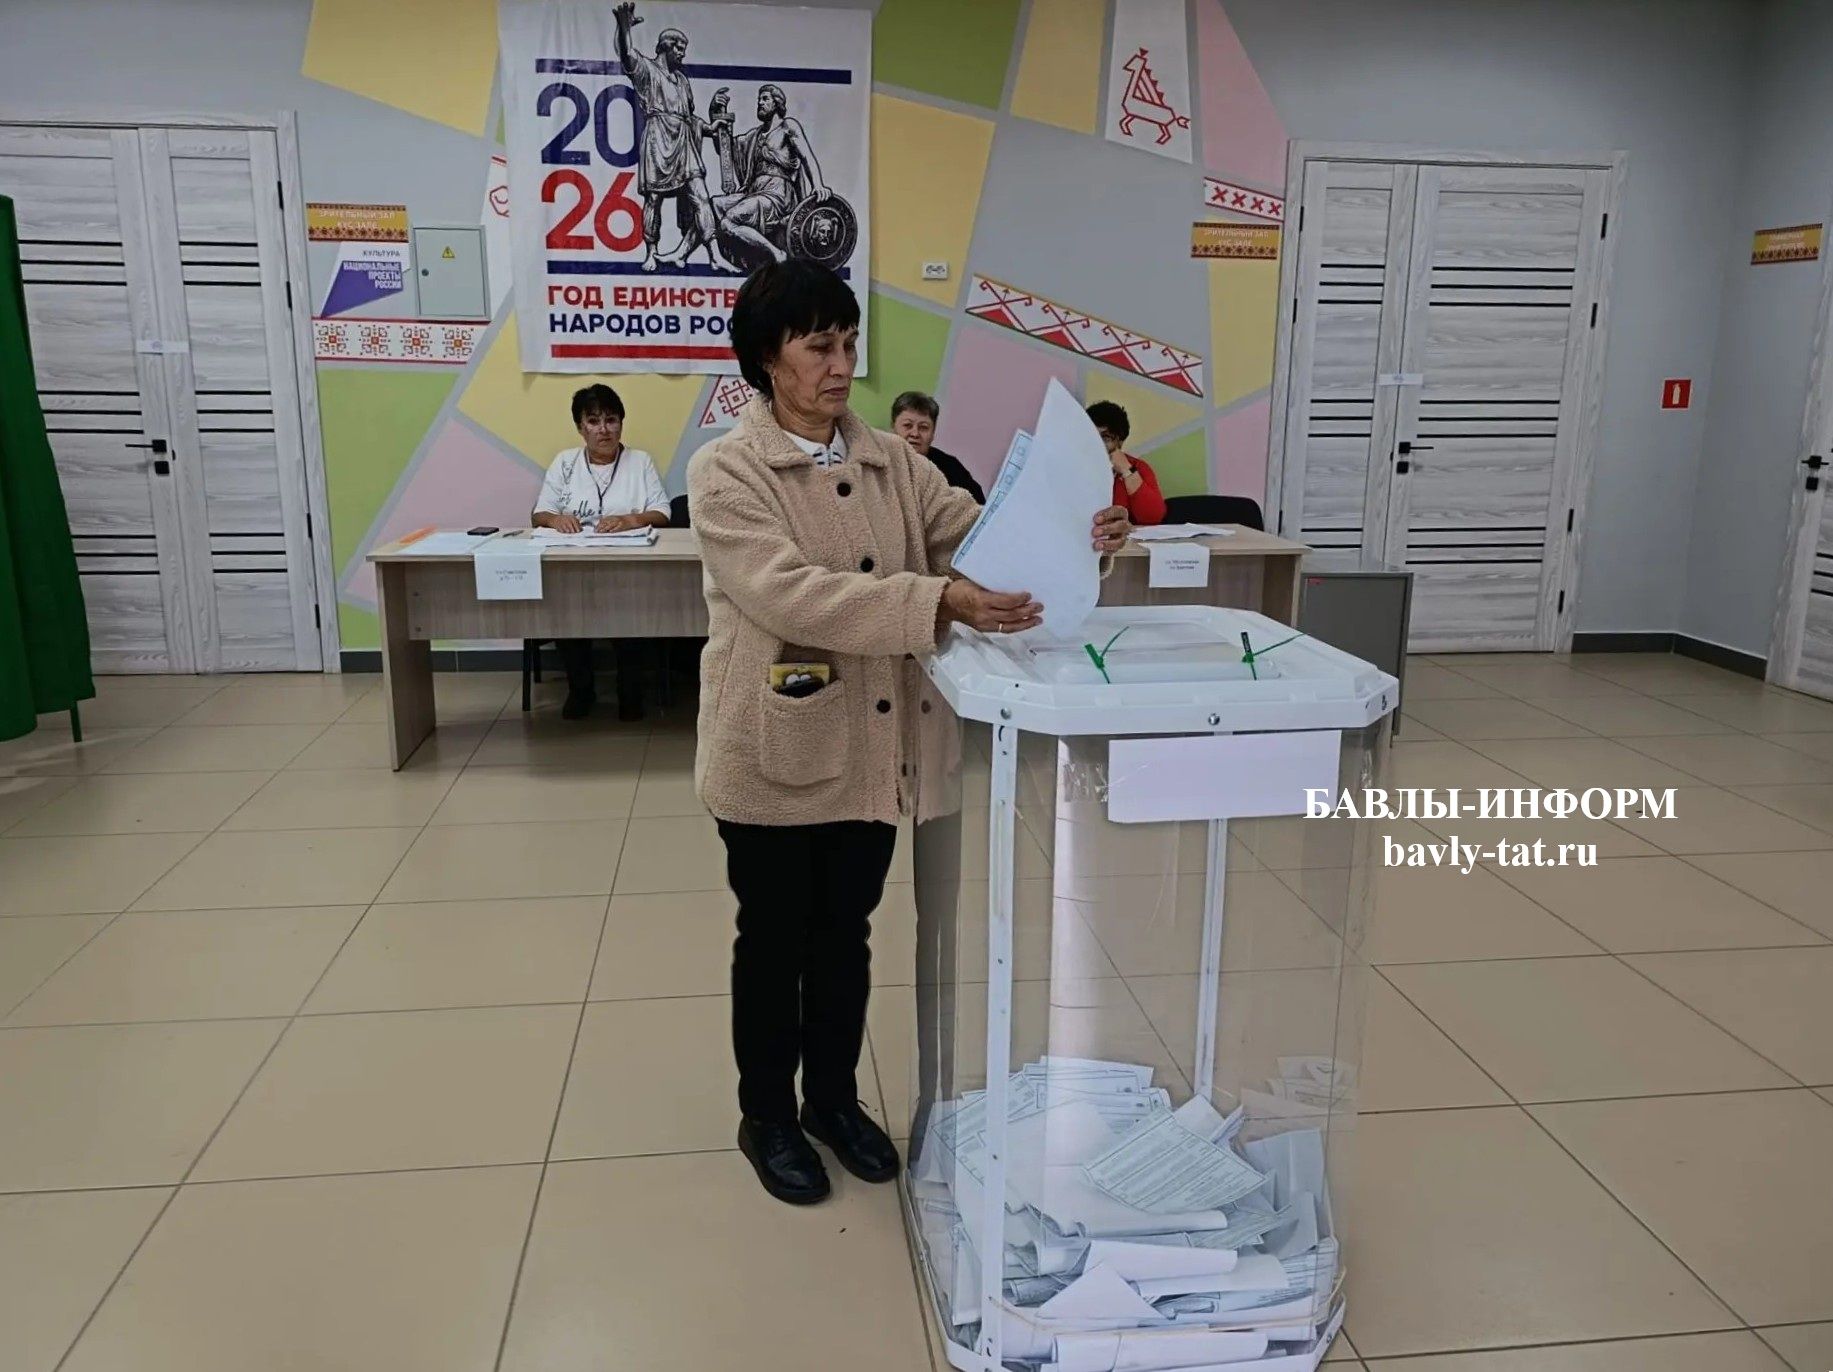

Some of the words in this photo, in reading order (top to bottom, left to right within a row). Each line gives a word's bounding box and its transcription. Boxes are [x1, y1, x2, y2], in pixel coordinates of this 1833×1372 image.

[536, 82, 645, 168] 20
[541, 168, 645, 252] 26
[363, 249, 401, 257] КУЛЬТУРА
[343, 261, 400, 271] НАЦИОНАЛЬНЫЕ
[368, 271, 401, 280] ПРОЕКТЫ
[374, 280, 402, 289] РОССИИ
[548, 285, 604, 309] ГОД
[613, 286, 740, 310] ЕДИНСТВ
[549, 313, 681, 337] НАРОДОВ
